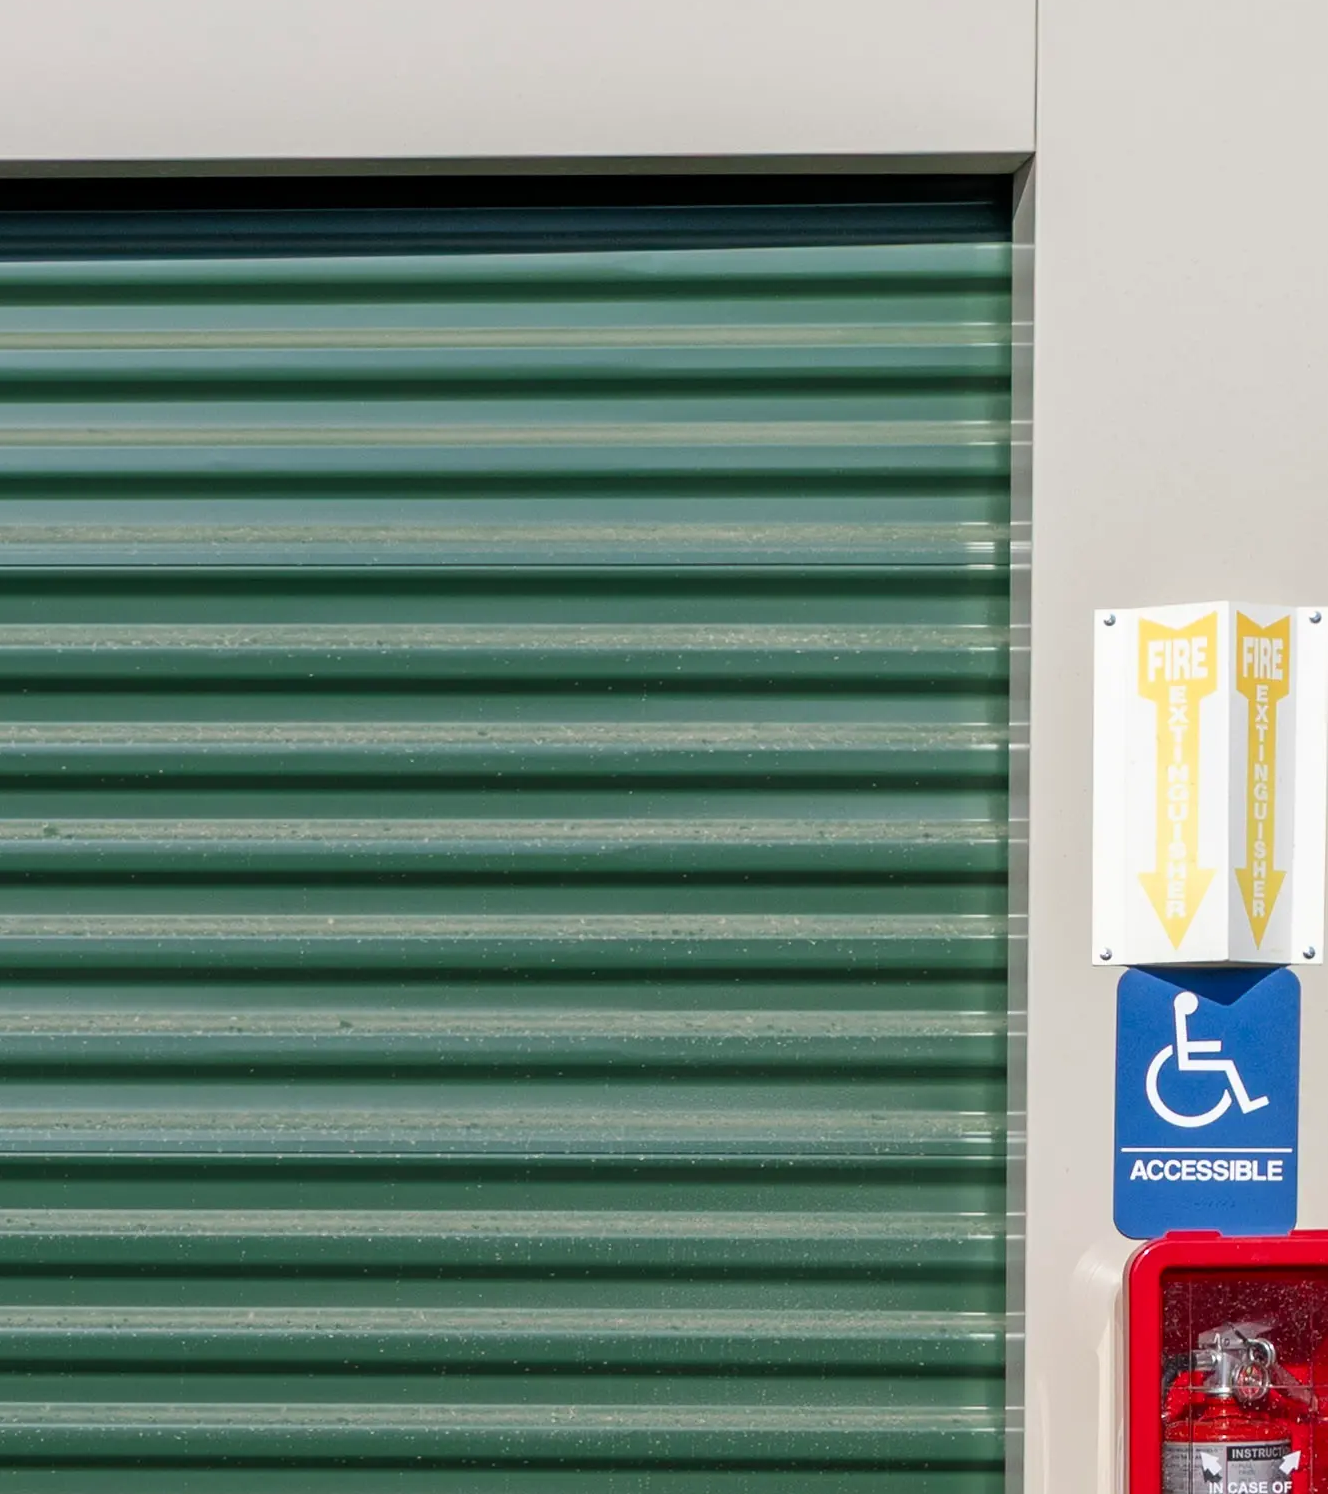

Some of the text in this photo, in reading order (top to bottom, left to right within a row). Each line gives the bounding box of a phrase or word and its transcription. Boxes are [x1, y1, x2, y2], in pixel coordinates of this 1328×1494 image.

[1147, 636, 1208, 682] FIRE
[1242, 636, 1283, 680] FIRE
[1166, 685, 1188, 919] EXTINGUISHER
[1252, 684, 1268, 918] EXTINGUISHER
[1130, 1159, 1283, 1182] ACCESSIBLE
[1209, 1481, 1292, 1494] IN CASE OF
